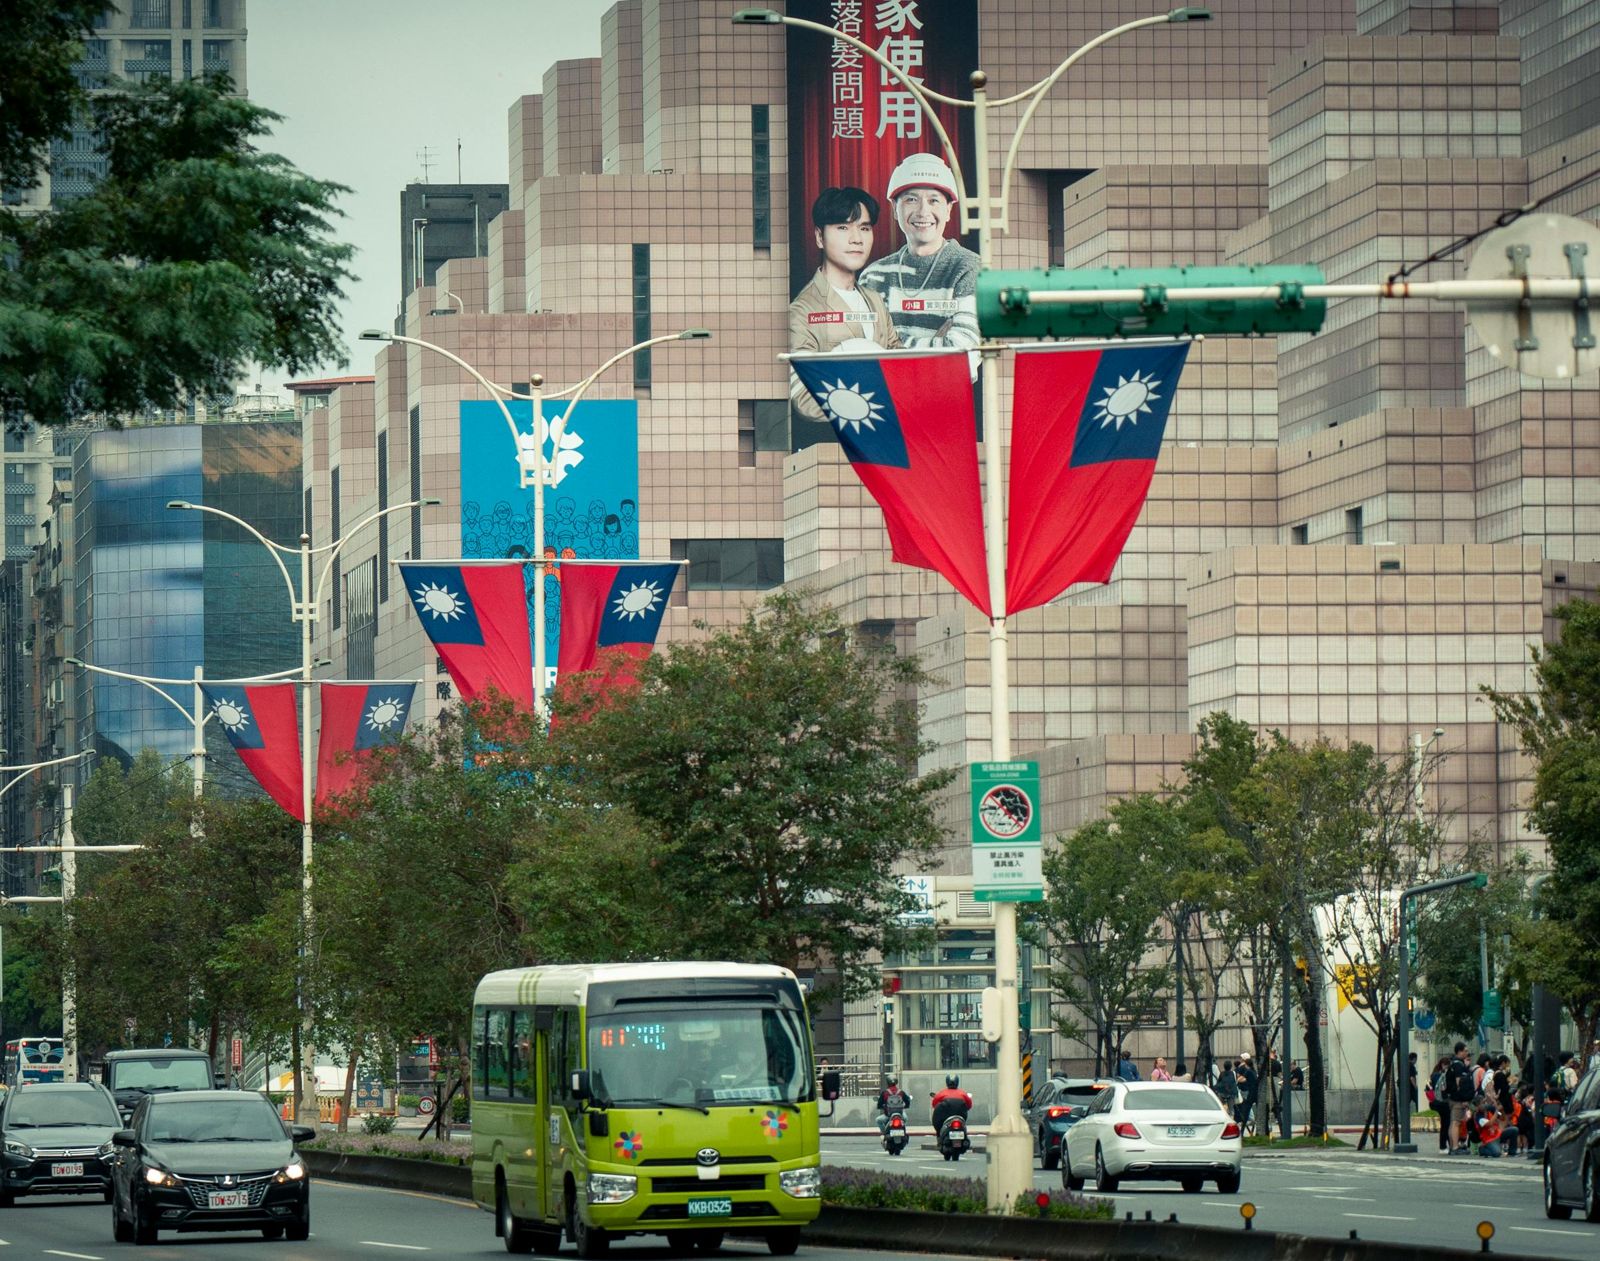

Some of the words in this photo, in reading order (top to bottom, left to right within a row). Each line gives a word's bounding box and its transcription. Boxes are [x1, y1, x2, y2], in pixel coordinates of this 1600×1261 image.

[830, 0, 864, 139] 落髮問題
[688, 1200, 732, 1214] KKB-0325
